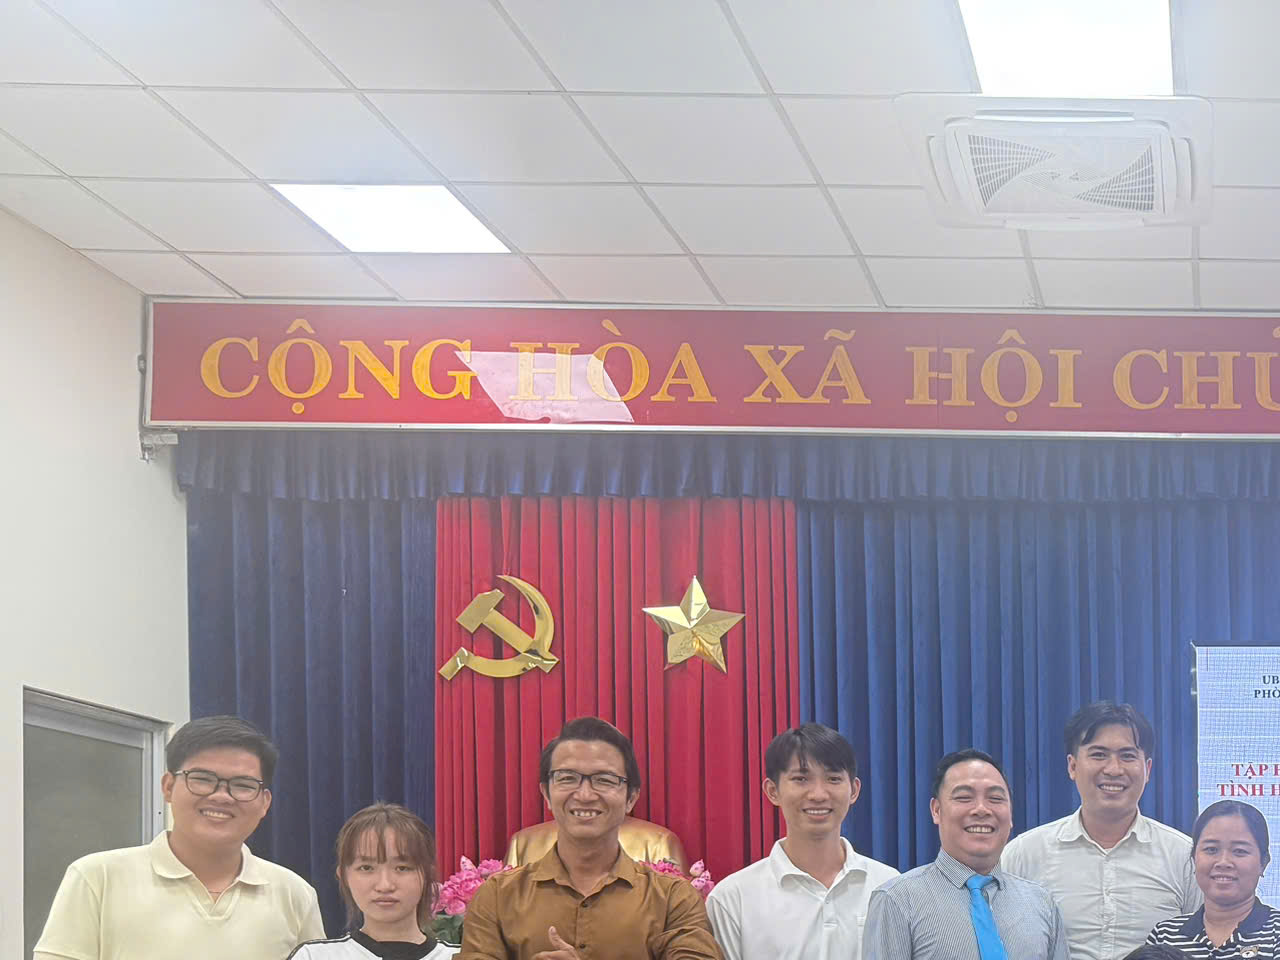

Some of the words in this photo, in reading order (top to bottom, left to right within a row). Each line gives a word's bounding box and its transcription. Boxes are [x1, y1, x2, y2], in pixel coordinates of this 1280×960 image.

[200, 318, 478, 415] CỘNG
[509, 318, 718, 403] HÒA
[743, 328, 872, 405] XÃ
[905, 328, 1083, 424] HỘI
[1232, 761, 1268, 780] TẬP
[1217, 779, 1264, 797] TÌNH
